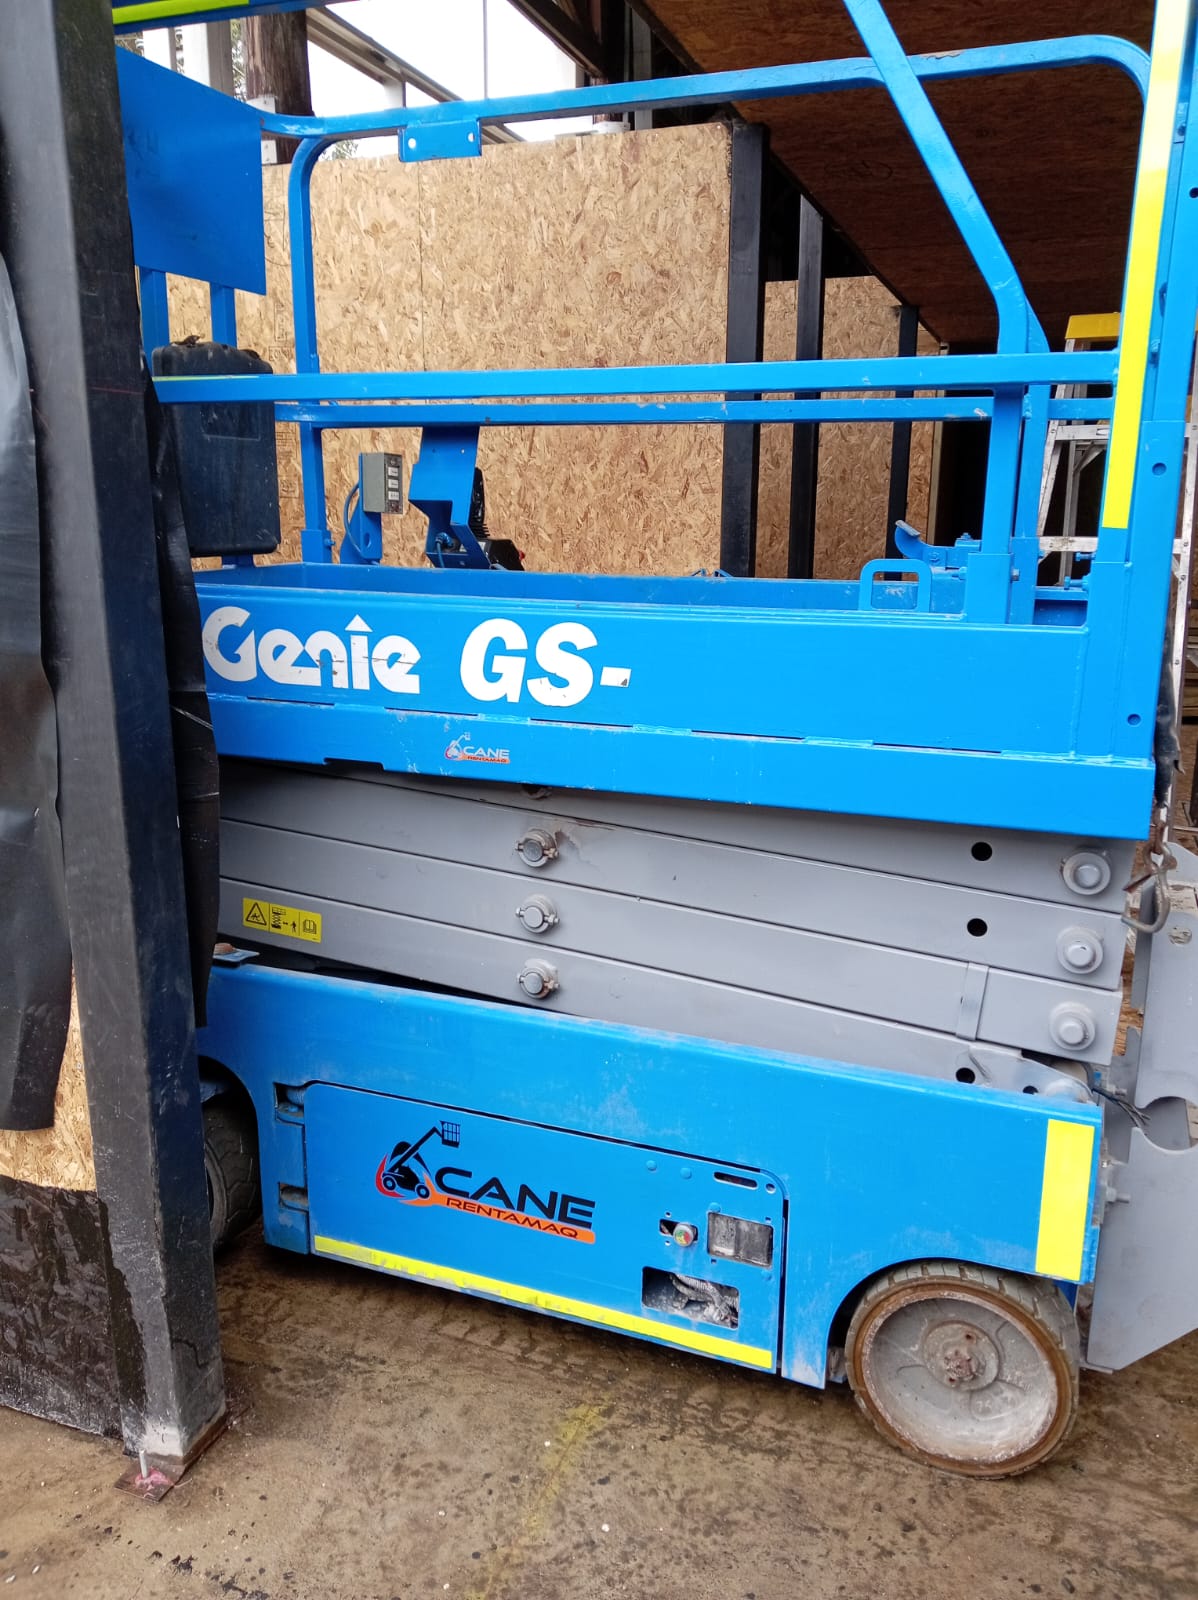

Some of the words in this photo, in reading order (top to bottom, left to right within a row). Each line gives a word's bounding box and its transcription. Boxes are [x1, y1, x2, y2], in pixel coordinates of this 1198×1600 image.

[202, 606, 421, 695] Genie
[460, 618, 632, 707] GS-
[463, 746, 510, 758] CANE
[434, 1166, 596, 1229] CANE
[446, 1197, 578, 1239] RENTAMAQ
